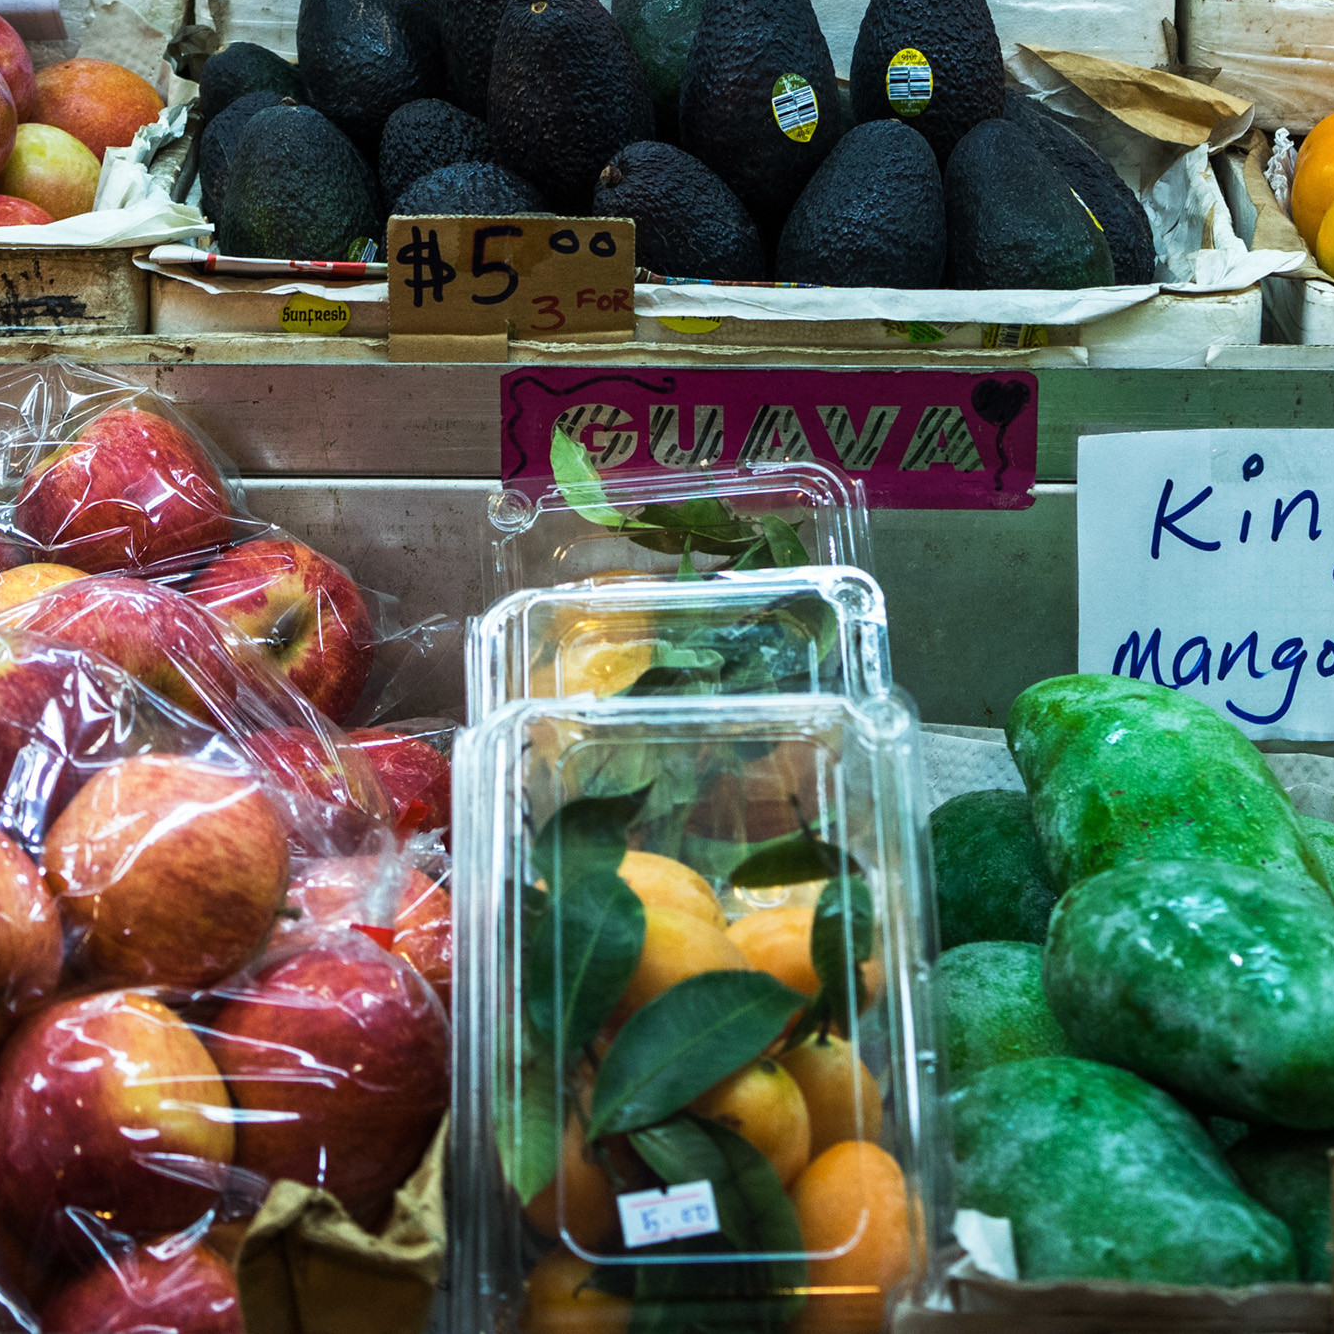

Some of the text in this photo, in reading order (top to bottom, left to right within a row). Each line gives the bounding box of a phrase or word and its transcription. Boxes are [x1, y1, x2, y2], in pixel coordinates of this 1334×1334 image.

[531, 287, 634, 331] 3 FOR
[552, 403, 984, 471] GUAVA
